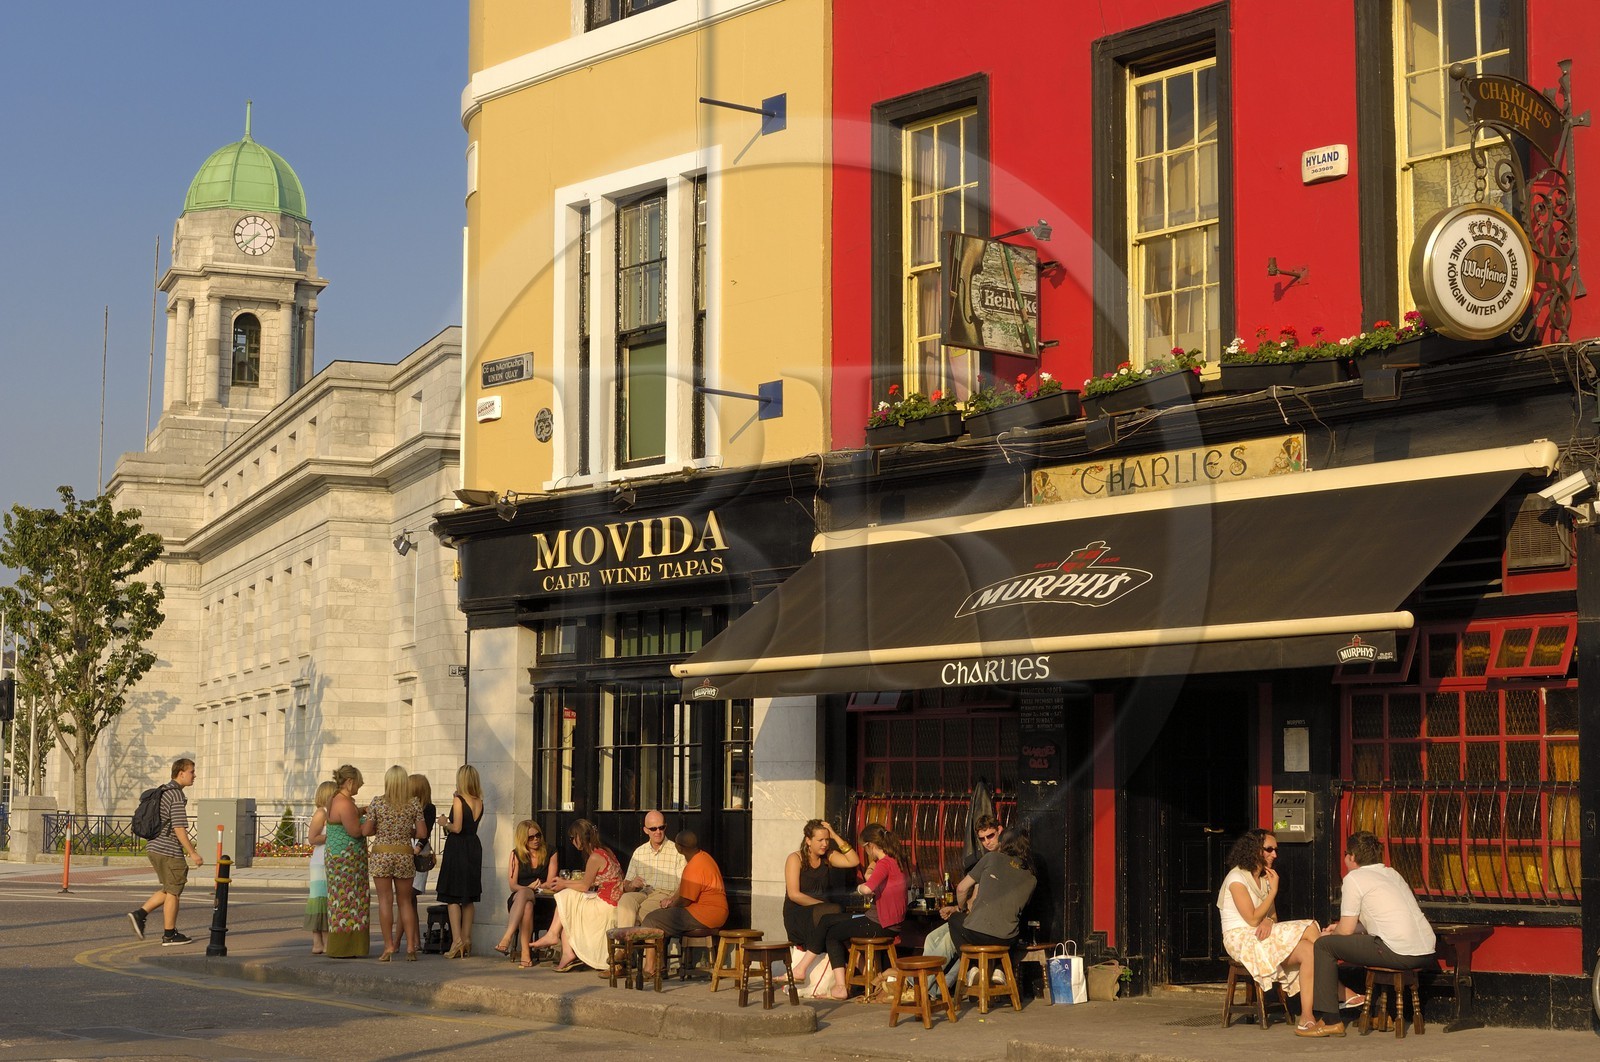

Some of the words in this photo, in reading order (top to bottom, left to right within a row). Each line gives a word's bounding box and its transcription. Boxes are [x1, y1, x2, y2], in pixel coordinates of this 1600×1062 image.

[1480, 82, 1552, 128] CHARLIES
[1500, 101, 1530, 130] BAR
[1306, 151, 1339, 167] HYLAND
[1450, 238, 1468, 261] EINE
[1447, 262, 1467, 307] KÖNIGIN
[1506, 248, 1518, 289] BIEREN
[1466, 302, 1497, 316] UNTER
[1498, 290, 1514, 310] DEN
[488, 373, 503, 382] UNION
[504, 370, 518, 380] QUAY
[1080, 445, 1248, 495] CHARLIES
[532, 510, 730, 572] MOVIDA
[542, 571, 590, 592] CAFE
[599, 565, 651, 585] WINE
[659, 556, 724, 580] TAPAS
